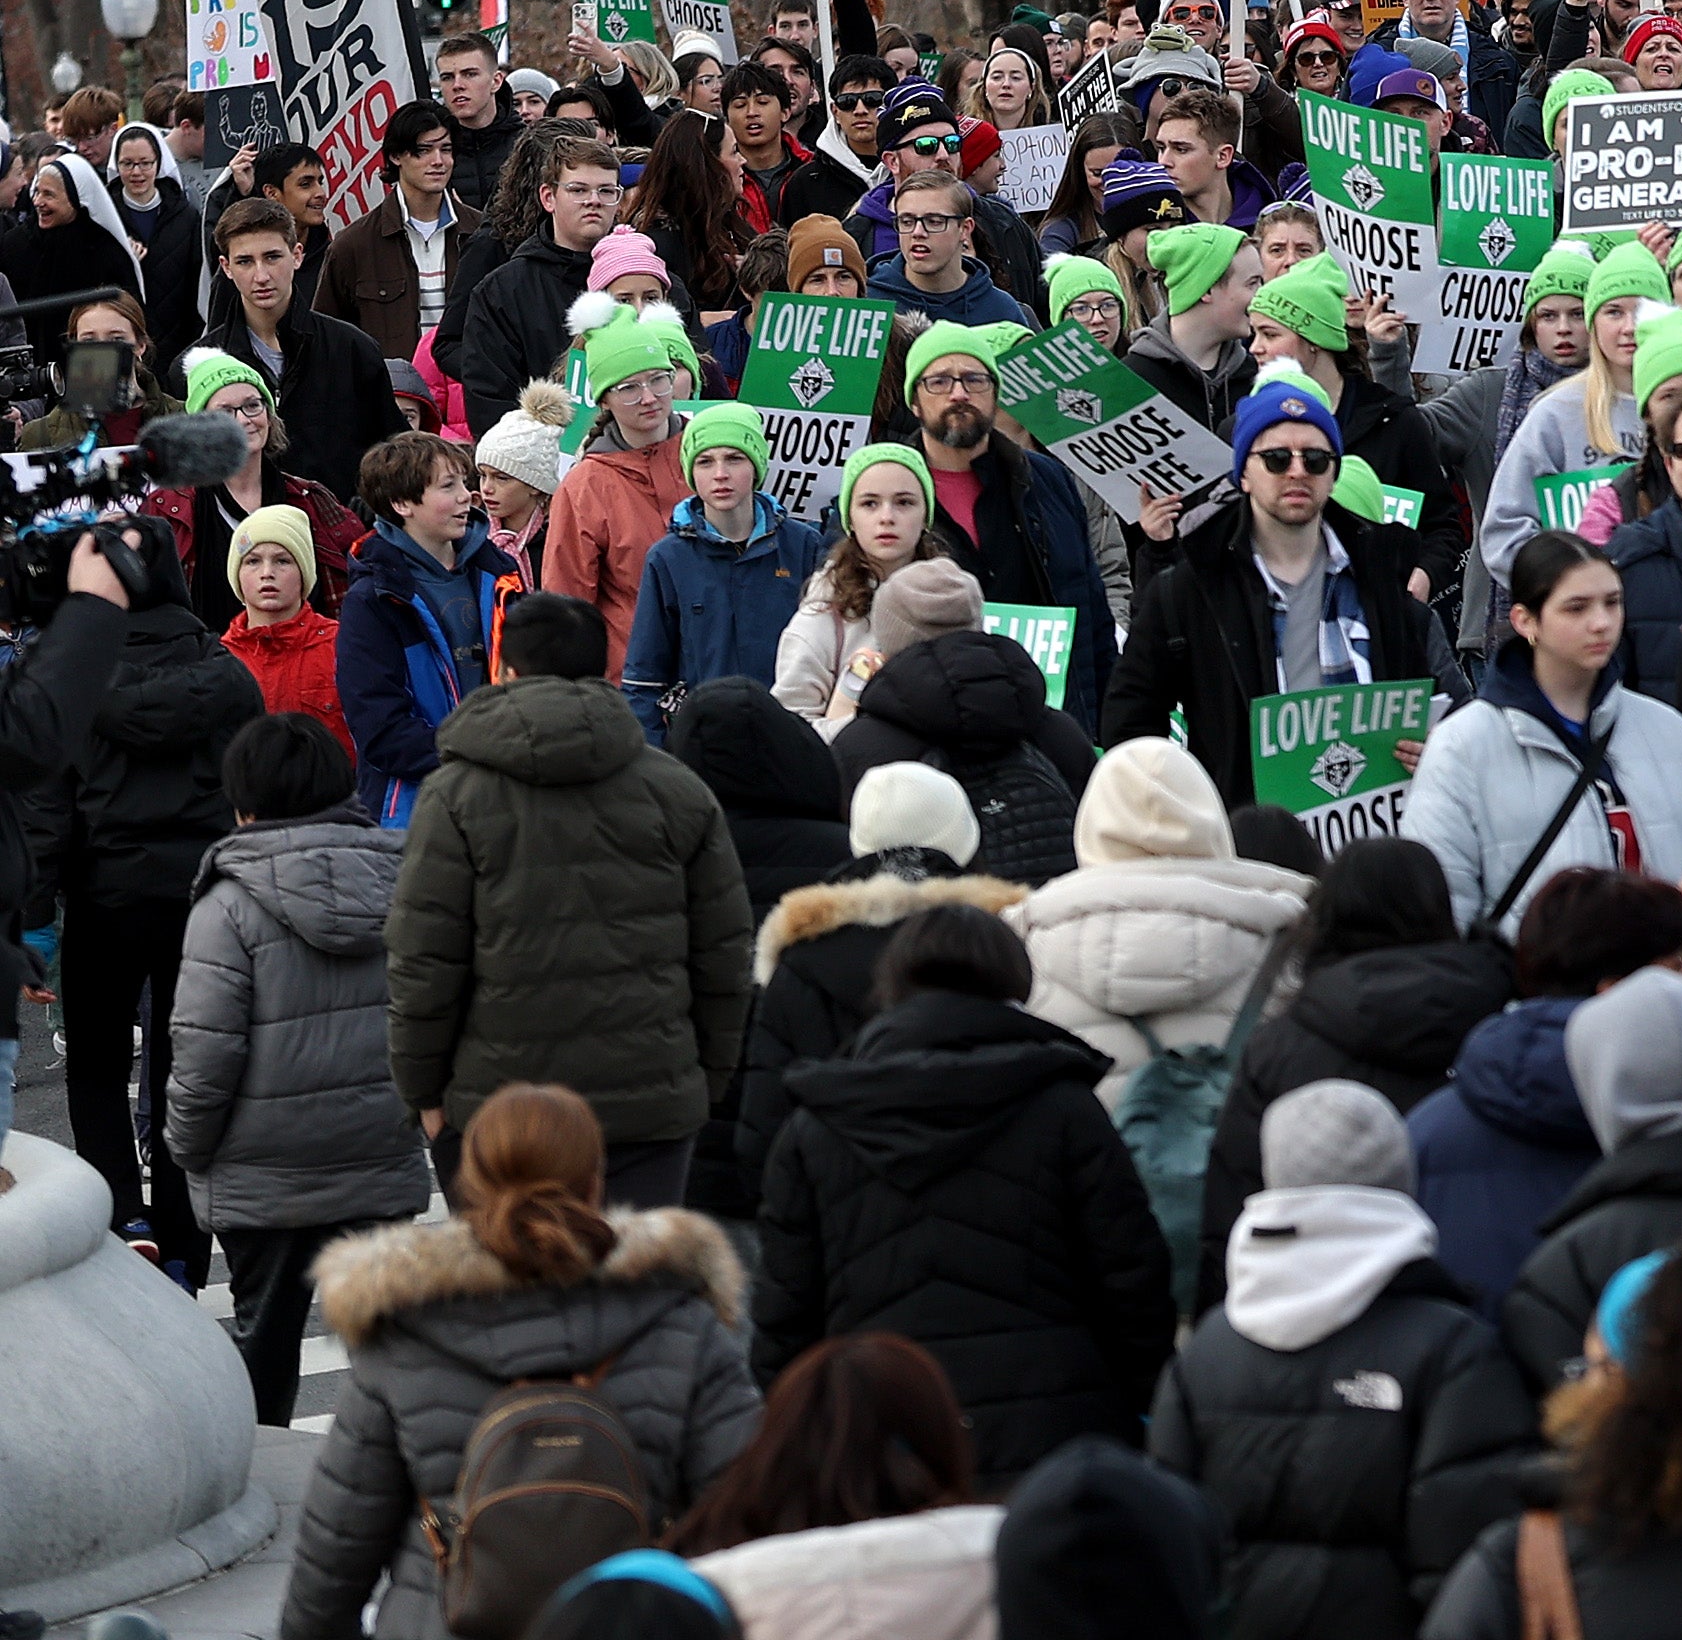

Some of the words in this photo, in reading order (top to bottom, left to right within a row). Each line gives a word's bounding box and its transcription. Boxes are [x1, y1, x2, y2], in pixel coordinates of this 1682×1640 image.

[239, 11, 260, 49] IS
[1072, 93, 1087, 121] AM
[1087, 72, 1108, 103] THE
[1305, 112, 1363, 161] LOVE
[1364, 126, 1425, 175] LIFE
[1581, 123, 1591, 145] I
[1607, 118, 1664, 144] AM
[1446, 162, 1501, 214] LOVE
[1505, 168, 1549, 219] LIFE
[1623, 211, 1643, 220] TEXT
[1644, 209, 1662, 219] LIFE
[1665, 208, 1676, 218] TO
[1325, 205, 1420, 273] CHOOSE
[1442, 272, 1528, 322] CHOOSE
[758, 302, 828, 354] LOVE
[828, 308, 888, 359] LIFE
[1032, 327, 1109, 382] LIFE
[1450, 325, 1503, 374] LIFE
[757, 413, 855, 467] HOOSE
[1067, 406, 1186, 475] CHOOSE
[768, 469, 817, 514] IFE
[1260, 693, 1343, 758] LOVE
[1351, 688, 1424, 735] LIFE
